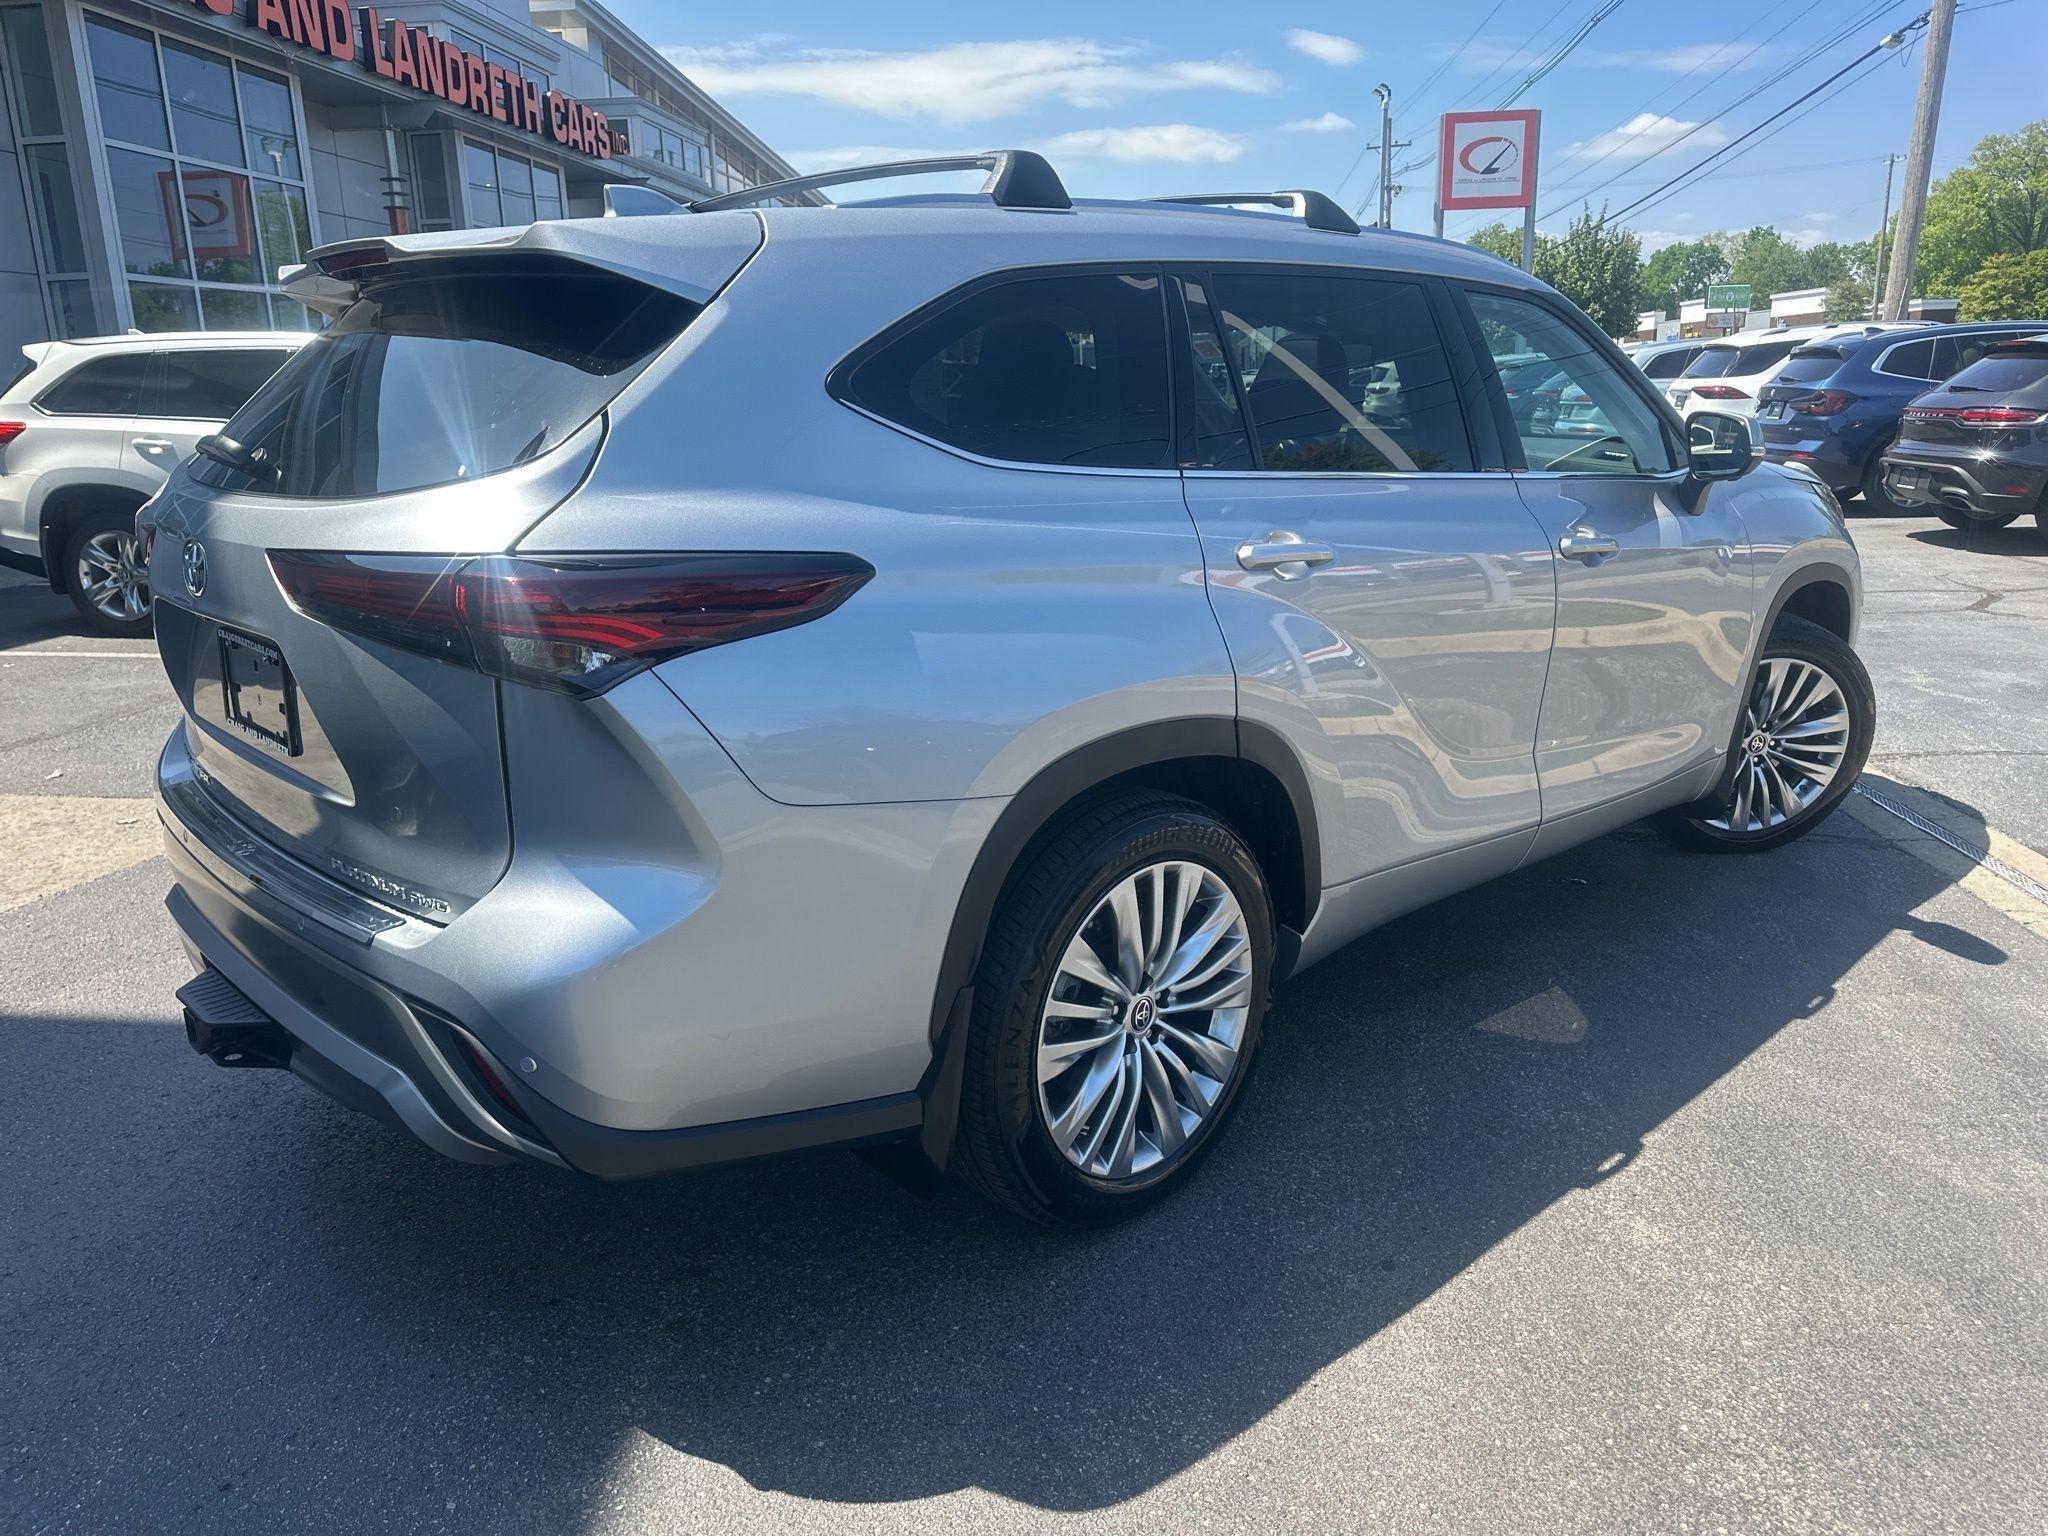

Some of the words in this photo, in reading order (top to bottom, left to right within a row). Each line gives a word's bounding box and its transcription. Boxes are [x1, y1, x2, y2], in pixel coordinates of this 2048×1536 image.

[256, 0, 354, 61] AND
[367, 6, 543, 135] LANDRETH
[549, 90, 611, 160] CARS
[227, 717, 245, 732] CRAIG
[245, 726, 258, 740] AND
[258, 732, 289, 756] LANDRETH
[331, 857, 406, 900] PLATINUM
[1004, 978, 1035, 1112] ALENZA
